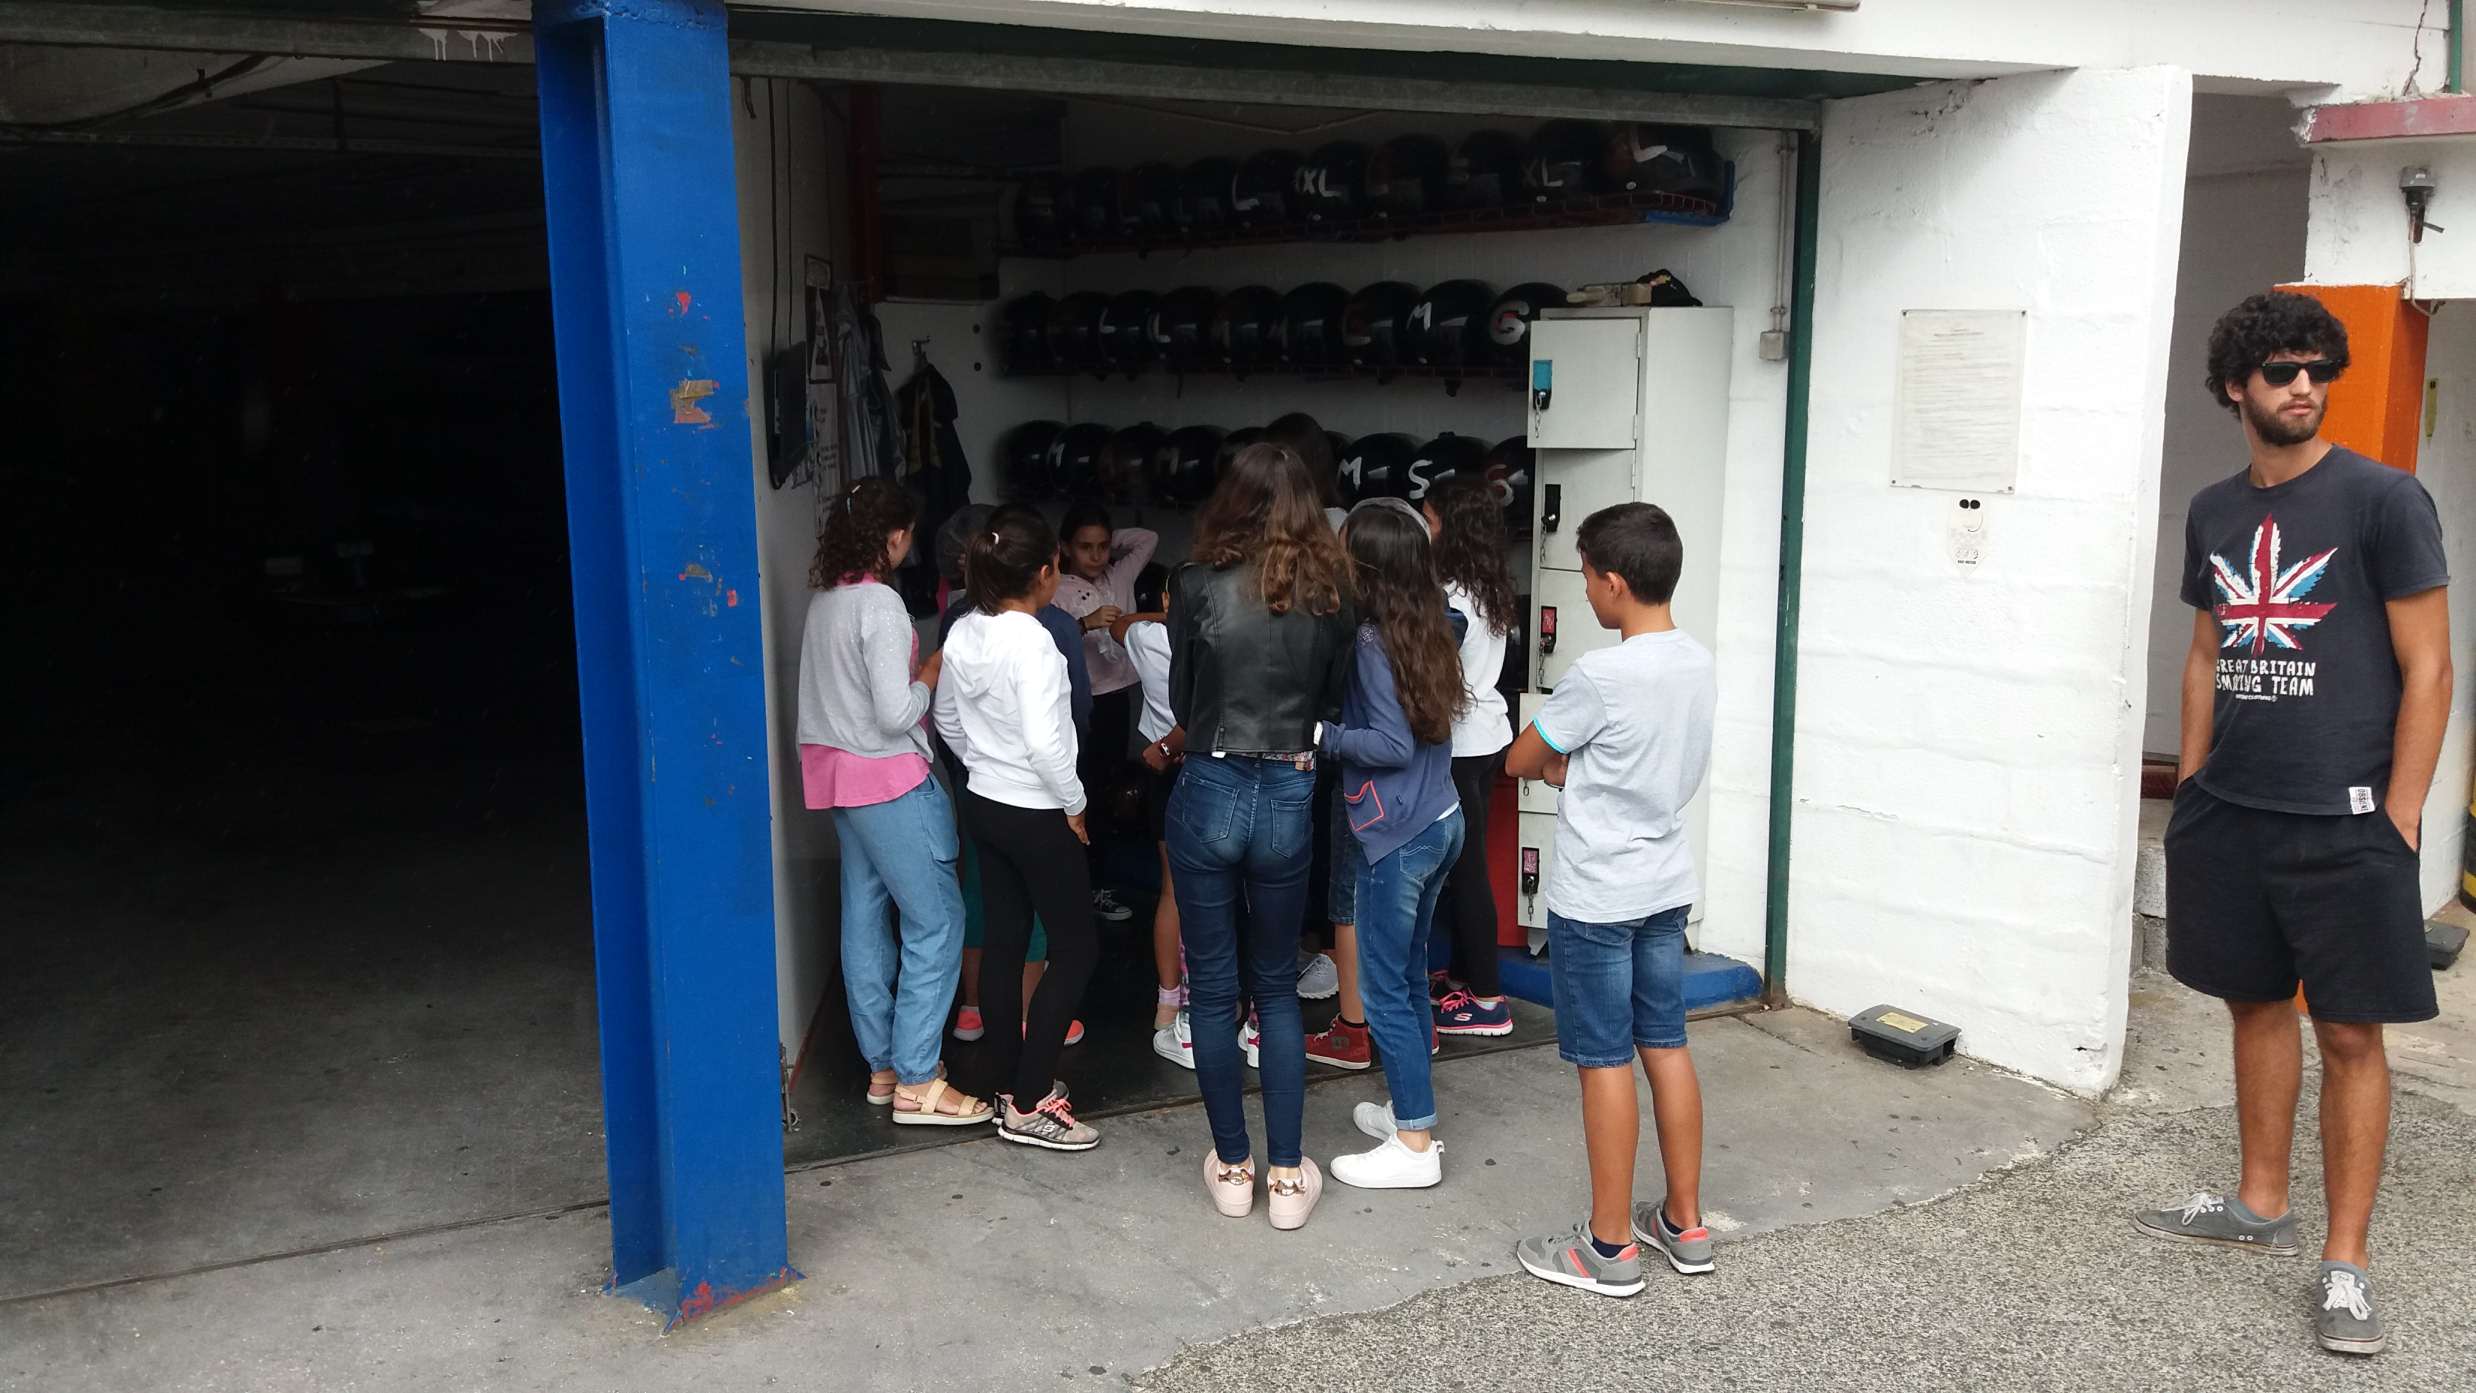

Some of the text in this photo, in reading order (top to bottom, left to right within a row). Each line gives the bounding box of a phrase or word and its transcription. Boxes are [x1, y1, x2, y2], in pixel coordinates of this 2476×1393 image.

[1406, 301, 1433, 333] M
[1337, 456, 1363, 492] M
[1408, 459, 1434, 500] S
[2250, 660, 2316, 676] BRITAIN
[2271, 676, 2314, 696] TEAM
